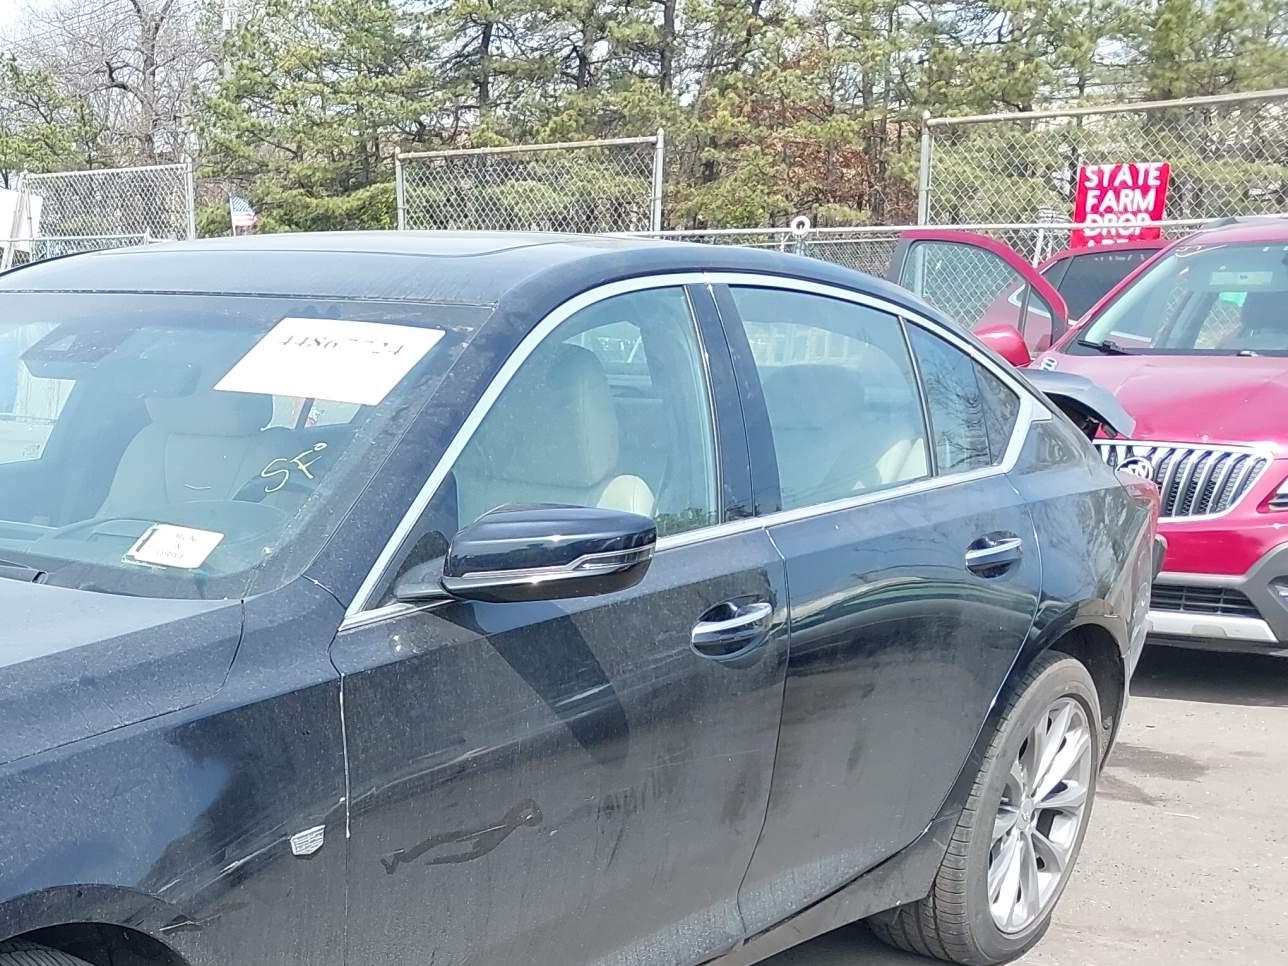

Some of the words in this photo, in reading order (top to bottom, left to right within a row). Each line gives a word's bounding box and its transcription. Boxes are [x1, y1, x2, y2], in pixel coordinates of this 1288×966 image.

[1084, 163, 1161, 188] STATE
[1085, 188, 1157, 212] FARM
[1083, 213, 1151, 237] DROP
